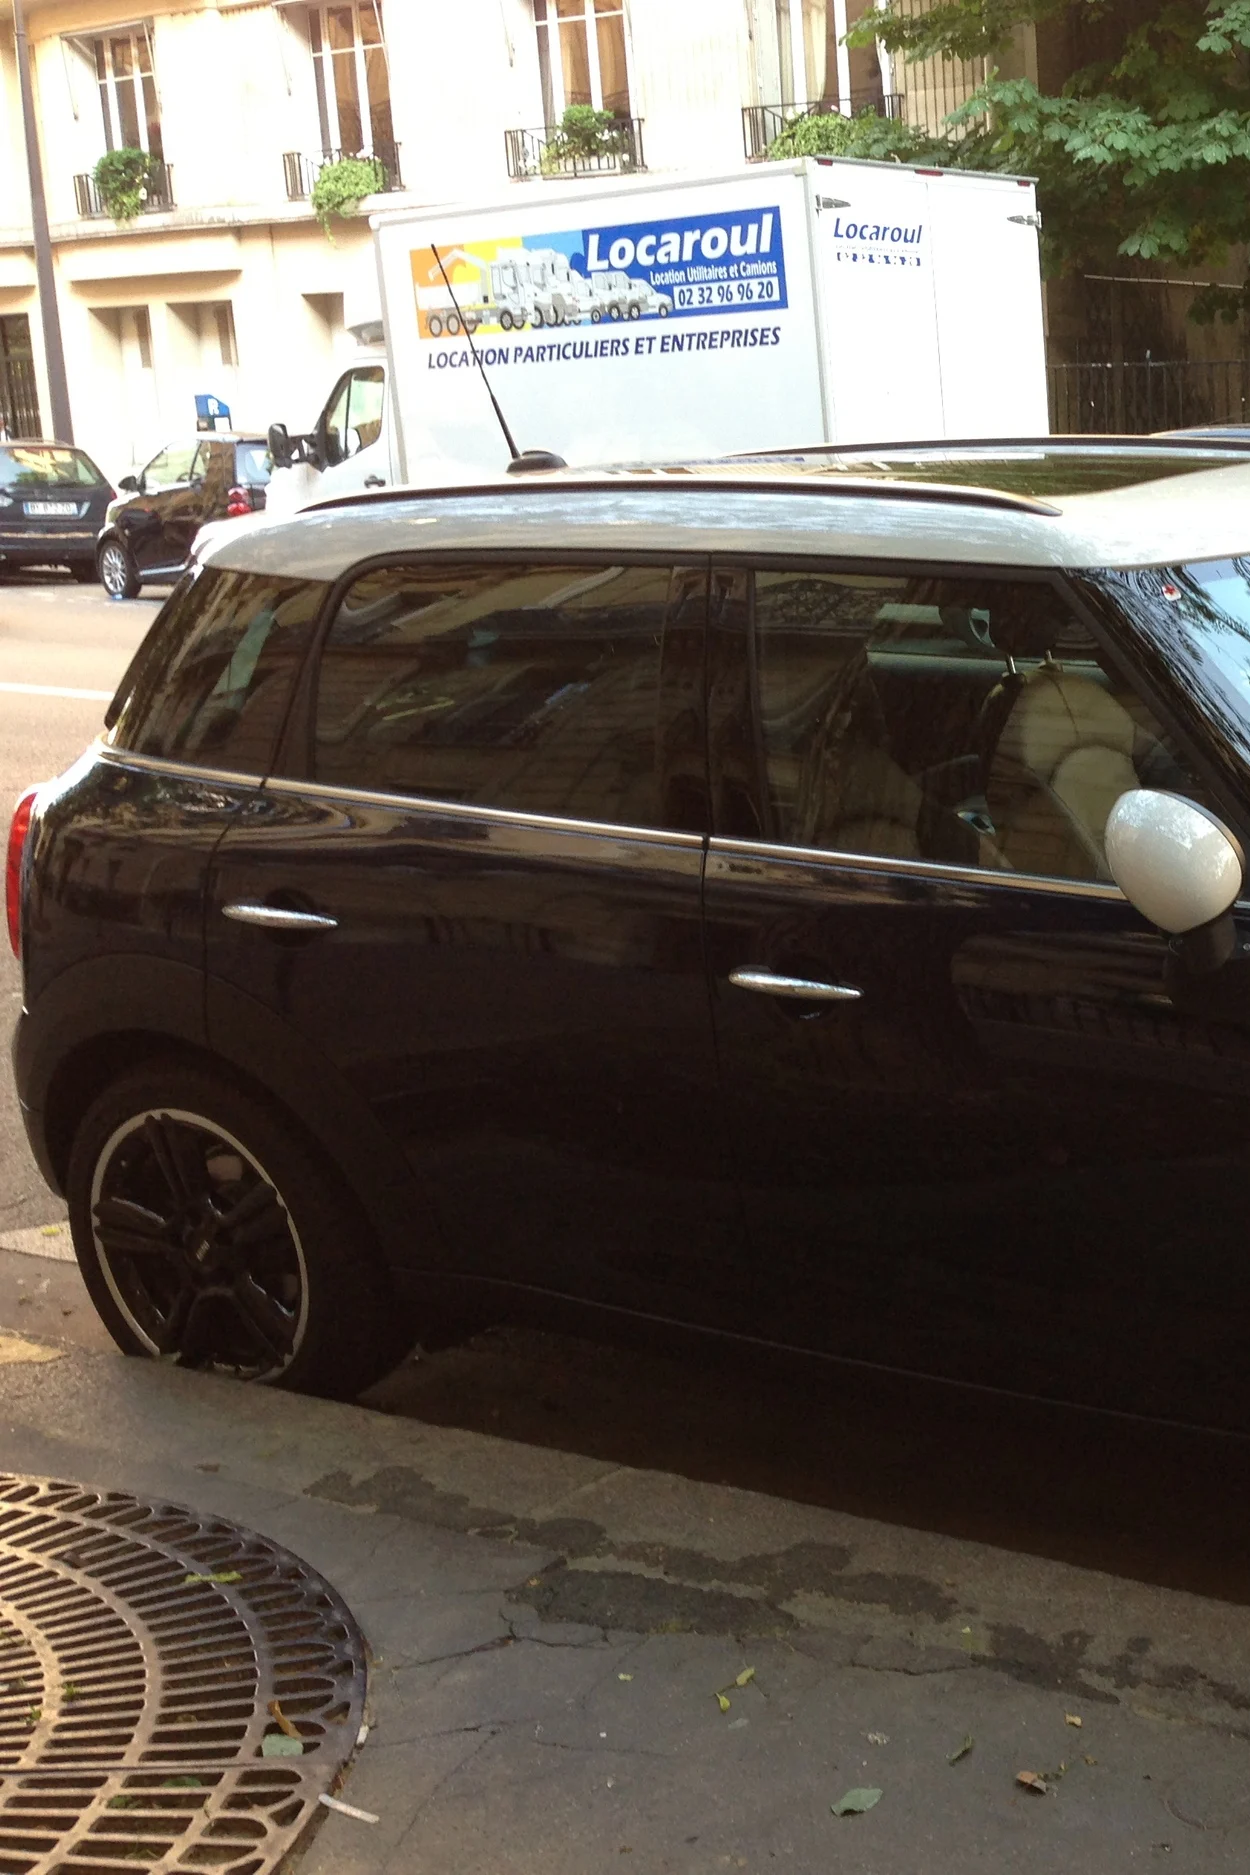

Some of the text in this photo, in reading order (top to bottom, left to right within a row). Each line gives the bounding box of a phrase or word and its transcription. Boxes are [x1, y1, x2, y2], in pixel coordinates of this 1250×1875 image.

[587, 213, 773, 271] Locaroul
[834, 217, 922, 243] Locaroul
[650, 260, 777, 286] Location Utilitaires et Camions
[678, 280, 774, 307] 02 32 96 96 20
[428, 326, 781, 369] LOCATION PARTICULIERS ET ENTREPRISES
